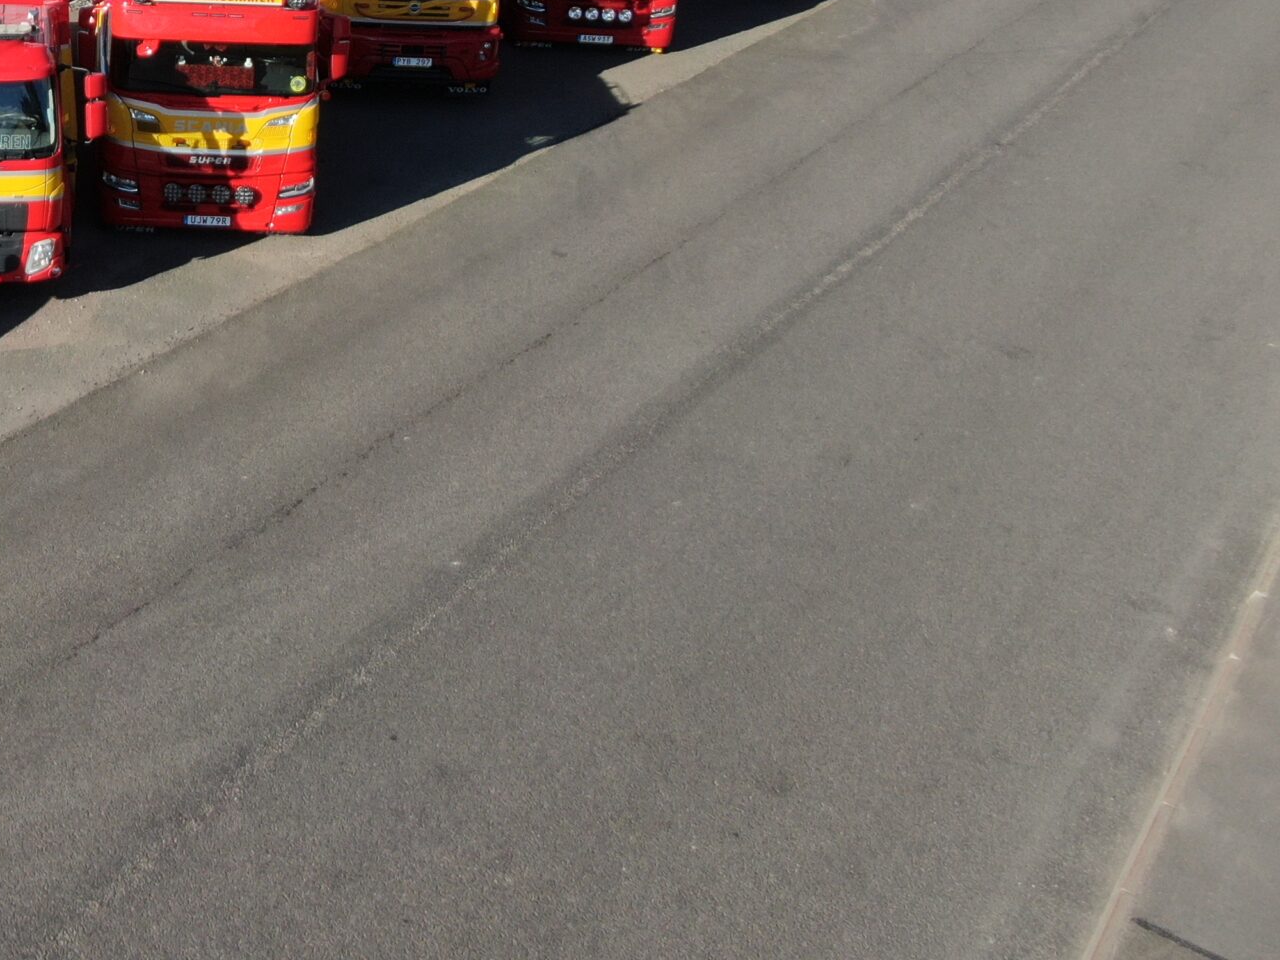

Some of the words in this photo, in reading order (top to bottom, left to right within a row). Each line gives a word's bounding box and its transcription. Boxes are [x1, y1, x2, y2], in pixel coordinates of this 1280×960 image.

[174, 119, 248, 133] SCANIA
[189, 155, 232, 165] SUPER
[190, 215, 208, 224] UJW
[209, 216, 228, 225] 79R
